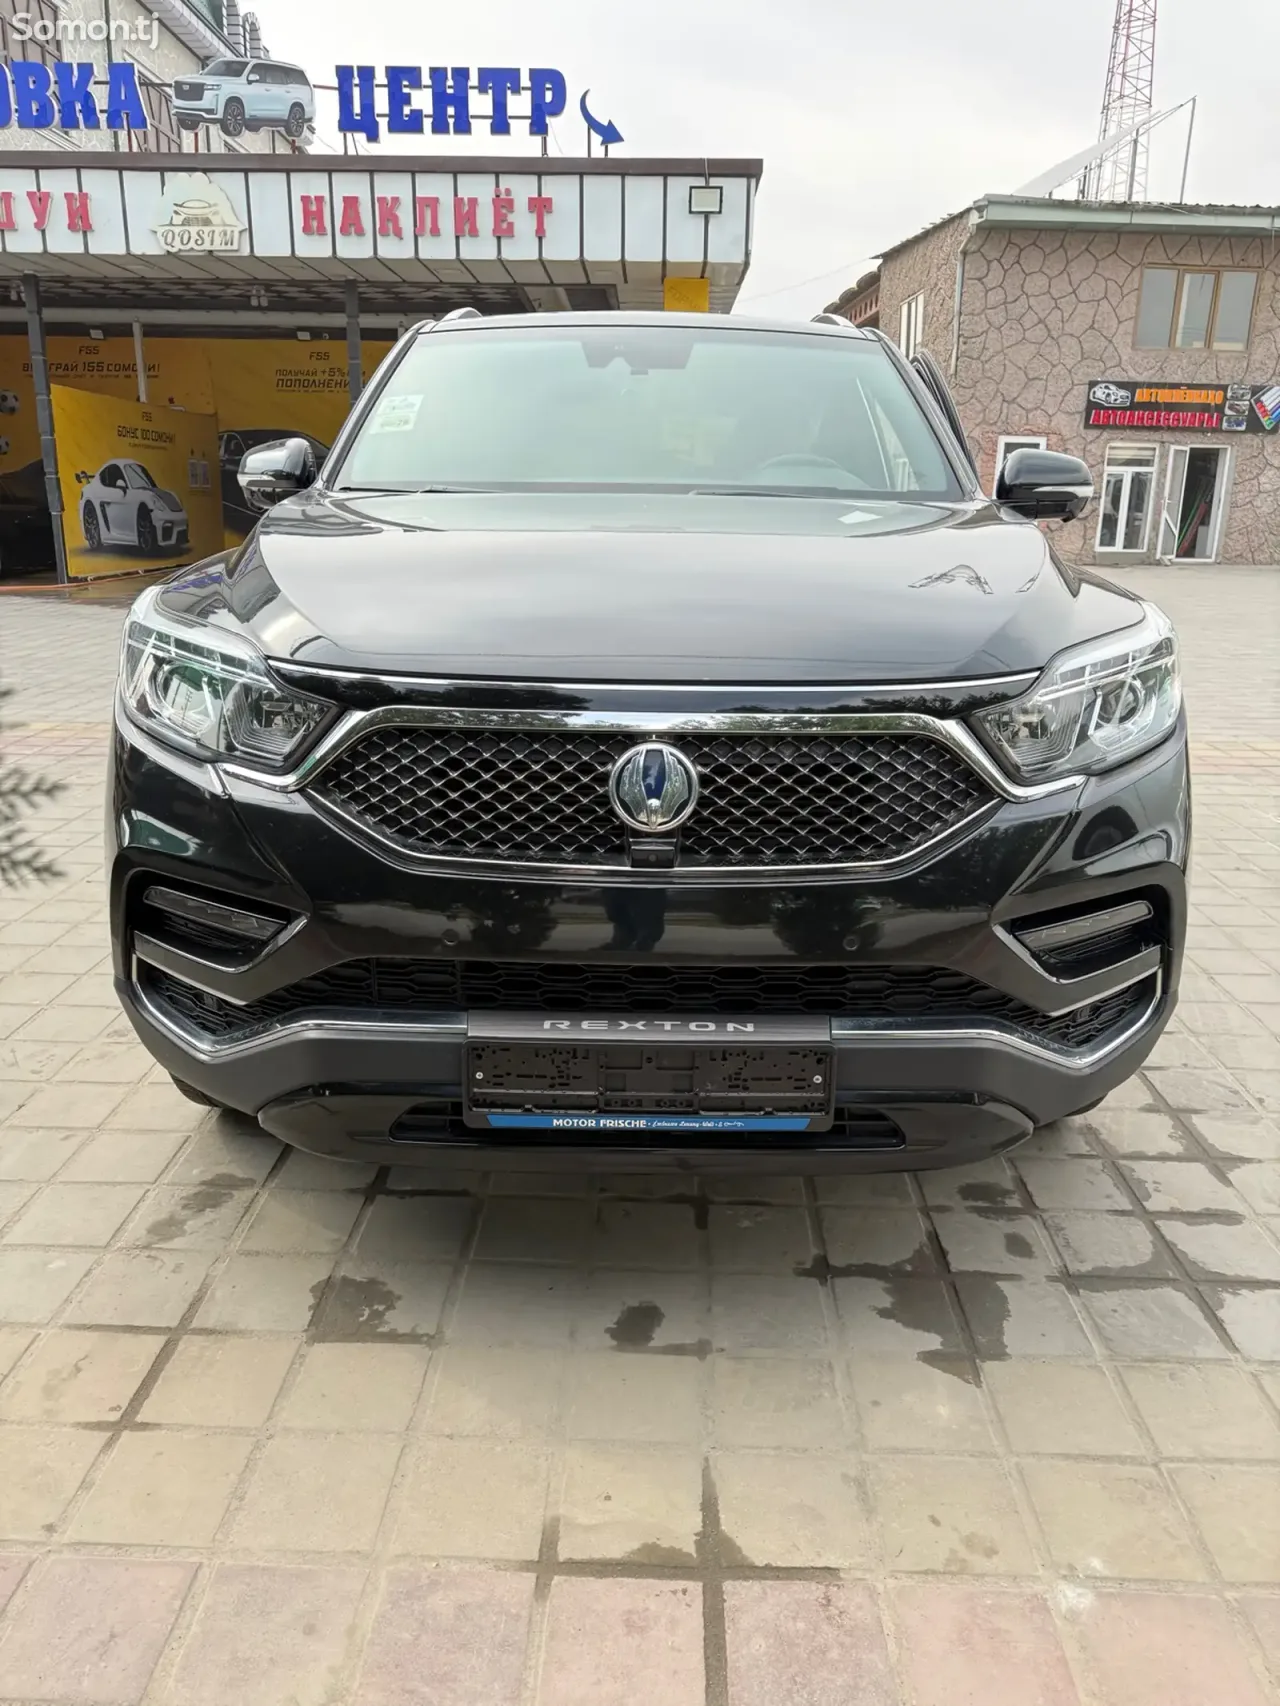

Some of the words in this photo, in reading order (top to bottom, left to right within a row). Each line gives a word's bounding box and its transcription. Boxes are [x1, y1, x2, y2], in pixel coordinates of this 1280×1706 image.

[0, 61, 150, 130] ВКА
[335, 64, 567, 143] ЦЕНТР
[300, 188, 553, 240] НАҚЛИЁТ
[161, 229, 235, 248] QOSIM
[22, 361, 78, 373] ВГРАЙ
[82, 361, 105, 372] 155
[543, 1020, 755, 1032] REXTON
[552, 1118, 597, 1128] MOTOR
[600, 1118, 647, 1129] FRISCHE
